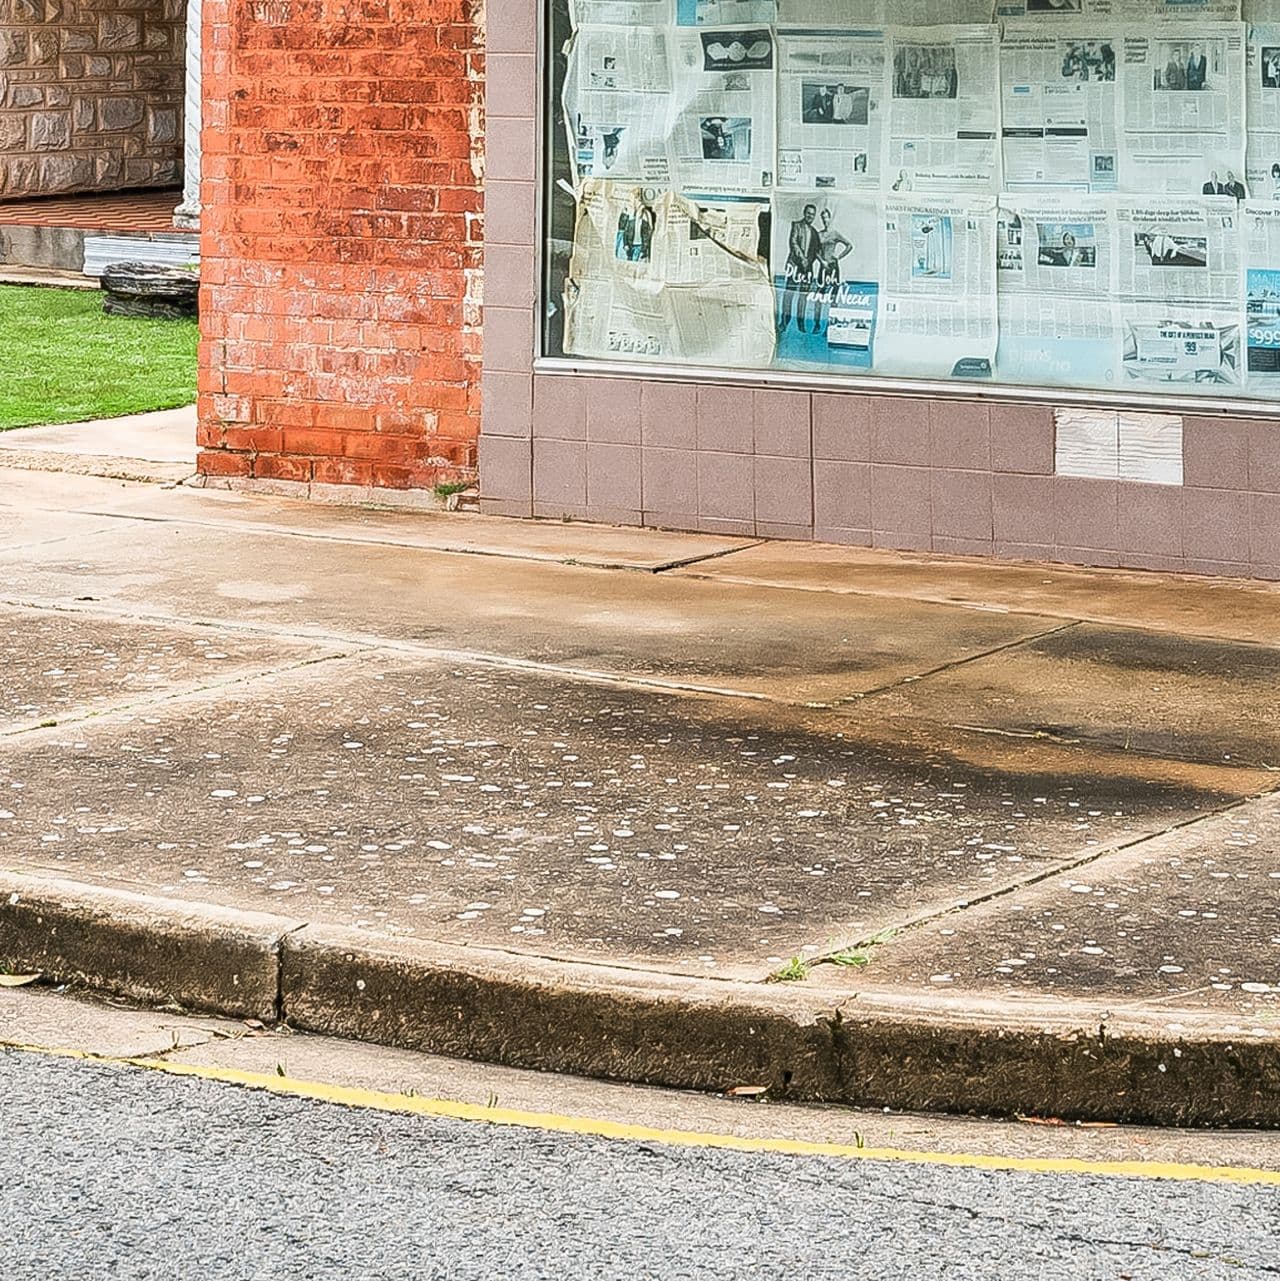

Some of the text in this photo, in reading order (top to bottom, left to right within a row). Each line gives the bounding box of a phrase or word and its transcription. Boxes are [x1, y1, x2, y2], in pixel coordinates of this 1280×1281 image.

[1245, 207, 1272, 217] Discover
[806, 286, 871, 305] and Necia
